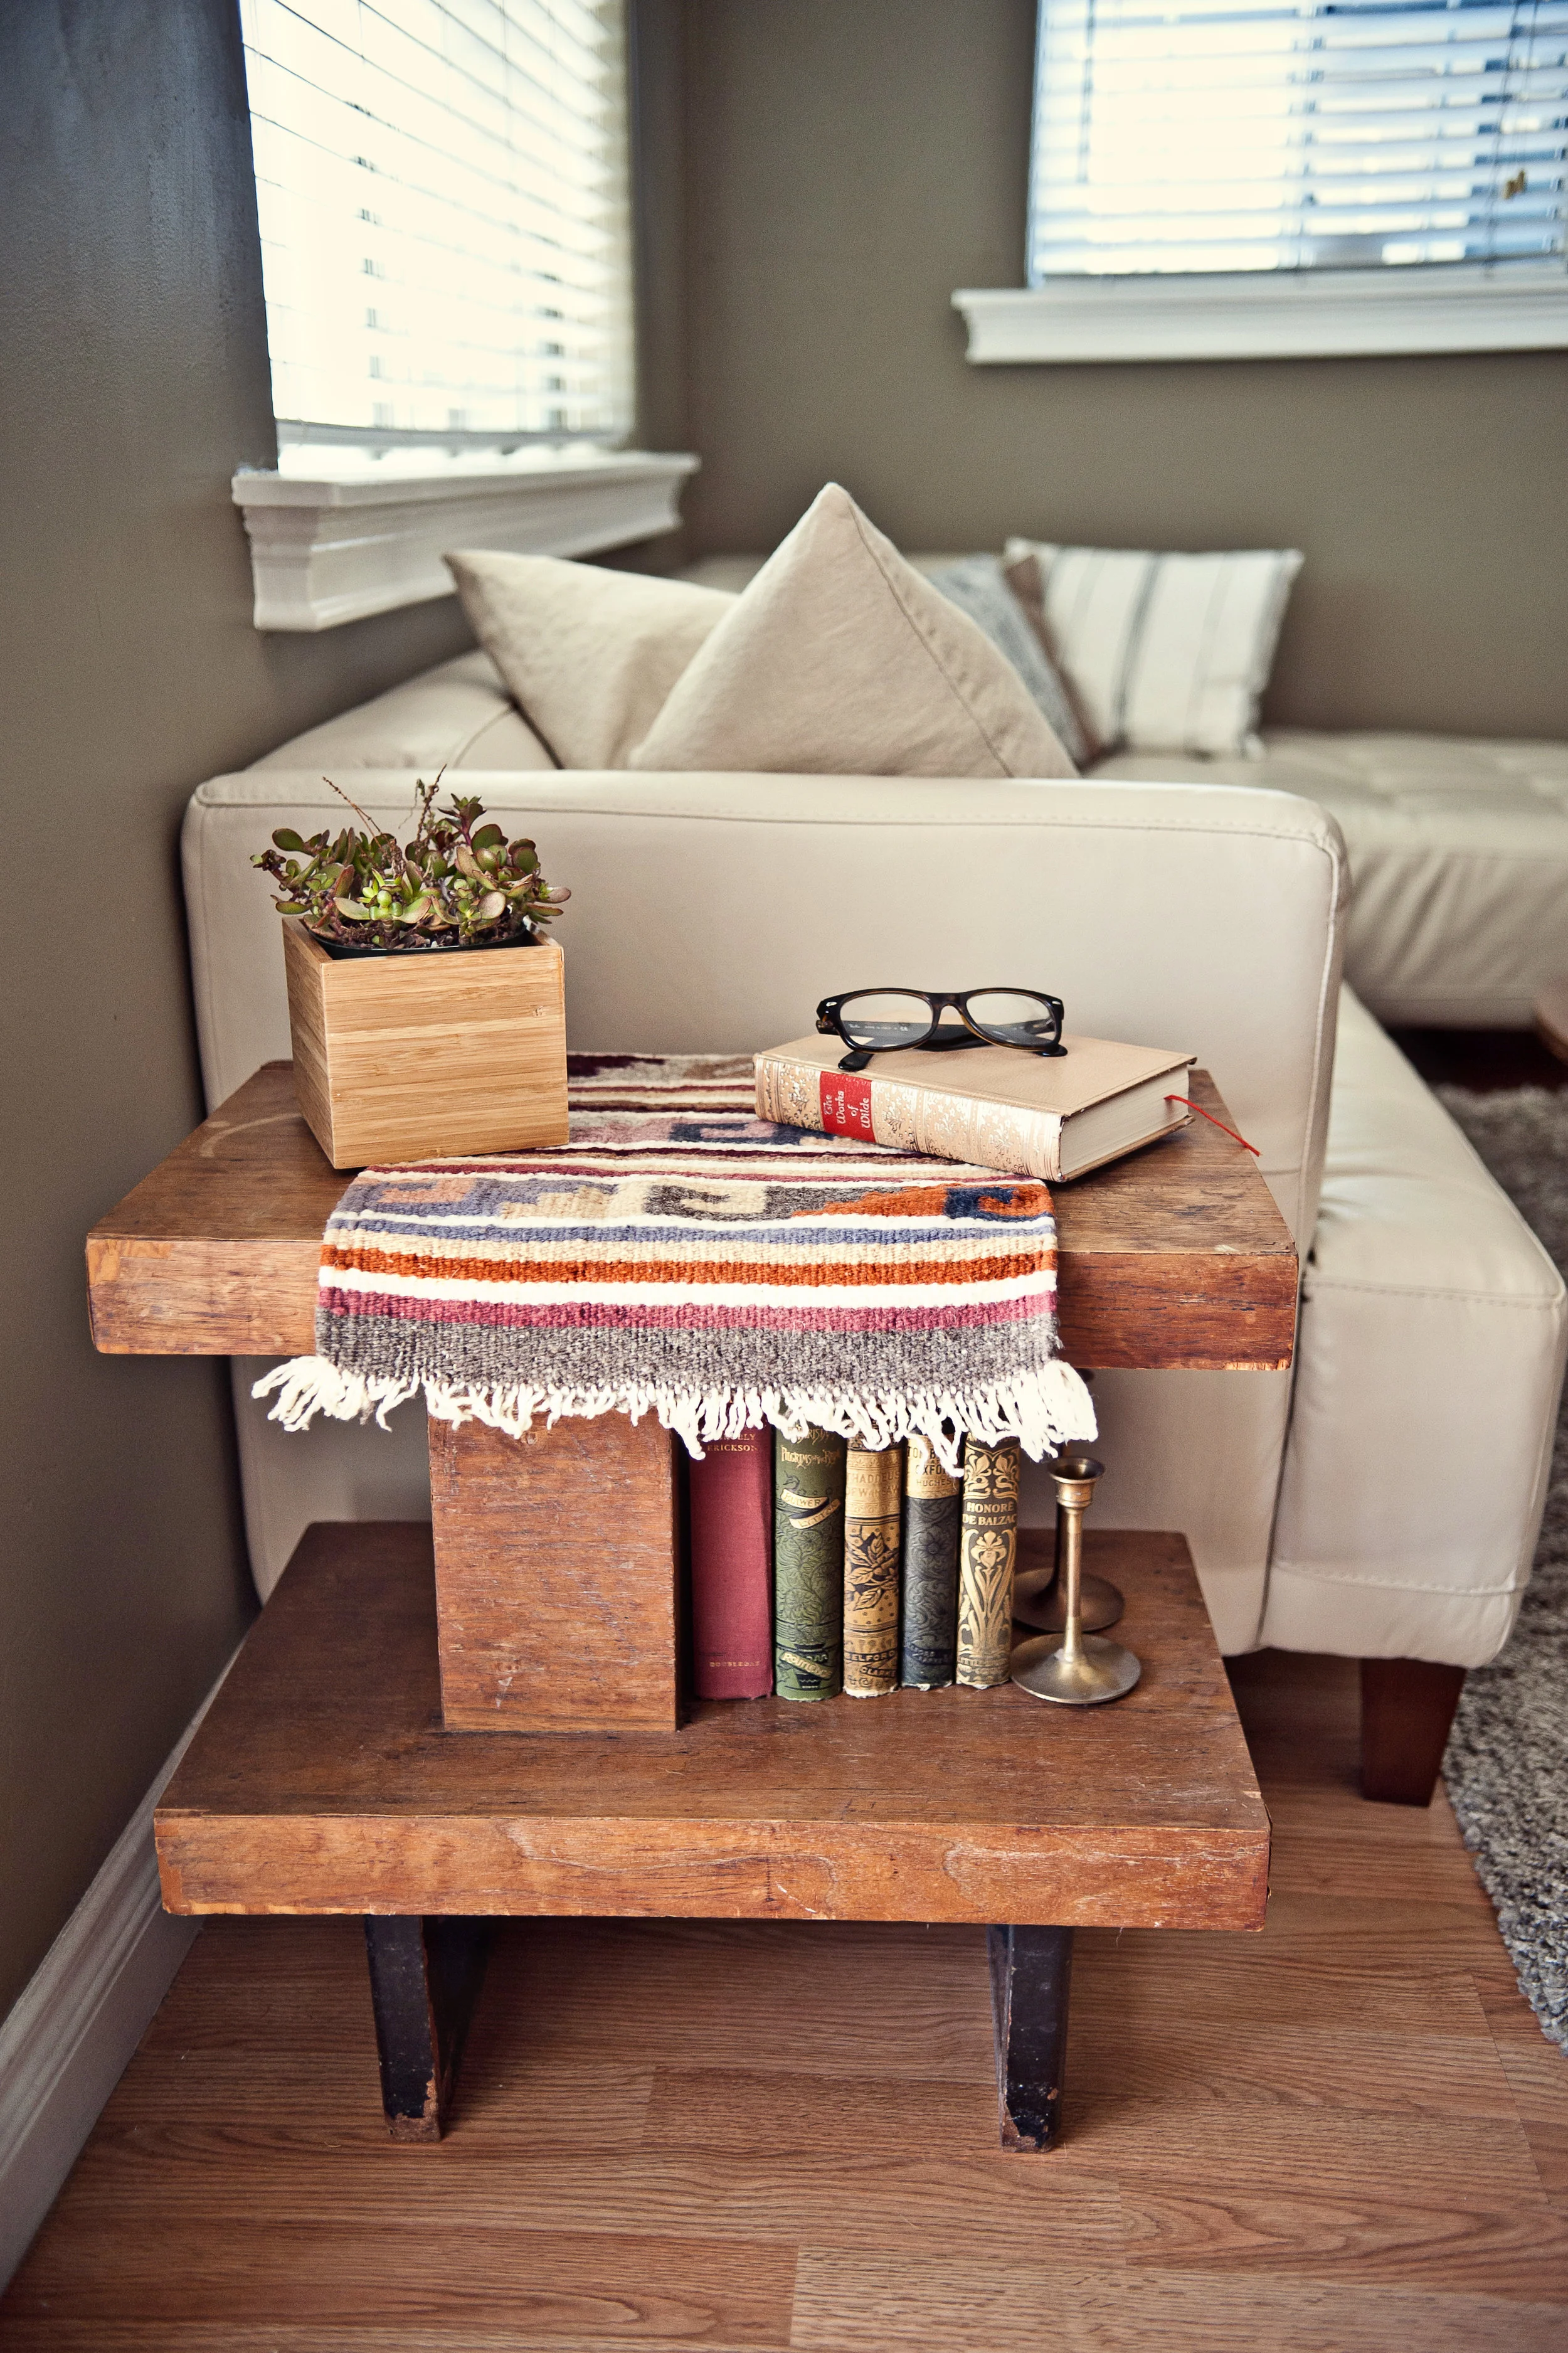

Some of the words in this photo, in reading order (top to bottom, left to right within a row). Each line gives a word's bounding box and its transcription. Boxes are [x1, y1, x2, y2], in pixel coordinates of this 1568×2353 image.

[823, 1094, 833, 1115] The
[834, 1090, 846, 1124] Works
[847, 1104, 859, 1117] of
[859, 1098, 871, 1129] Wilde
[845, 1470, 899, 1484] THADDEUS
[916, 1478, 951, 1487] HUGHES
[962, 1513, 977, 1525] DE
[978, 1514, 1017, 1526] BALZAC
